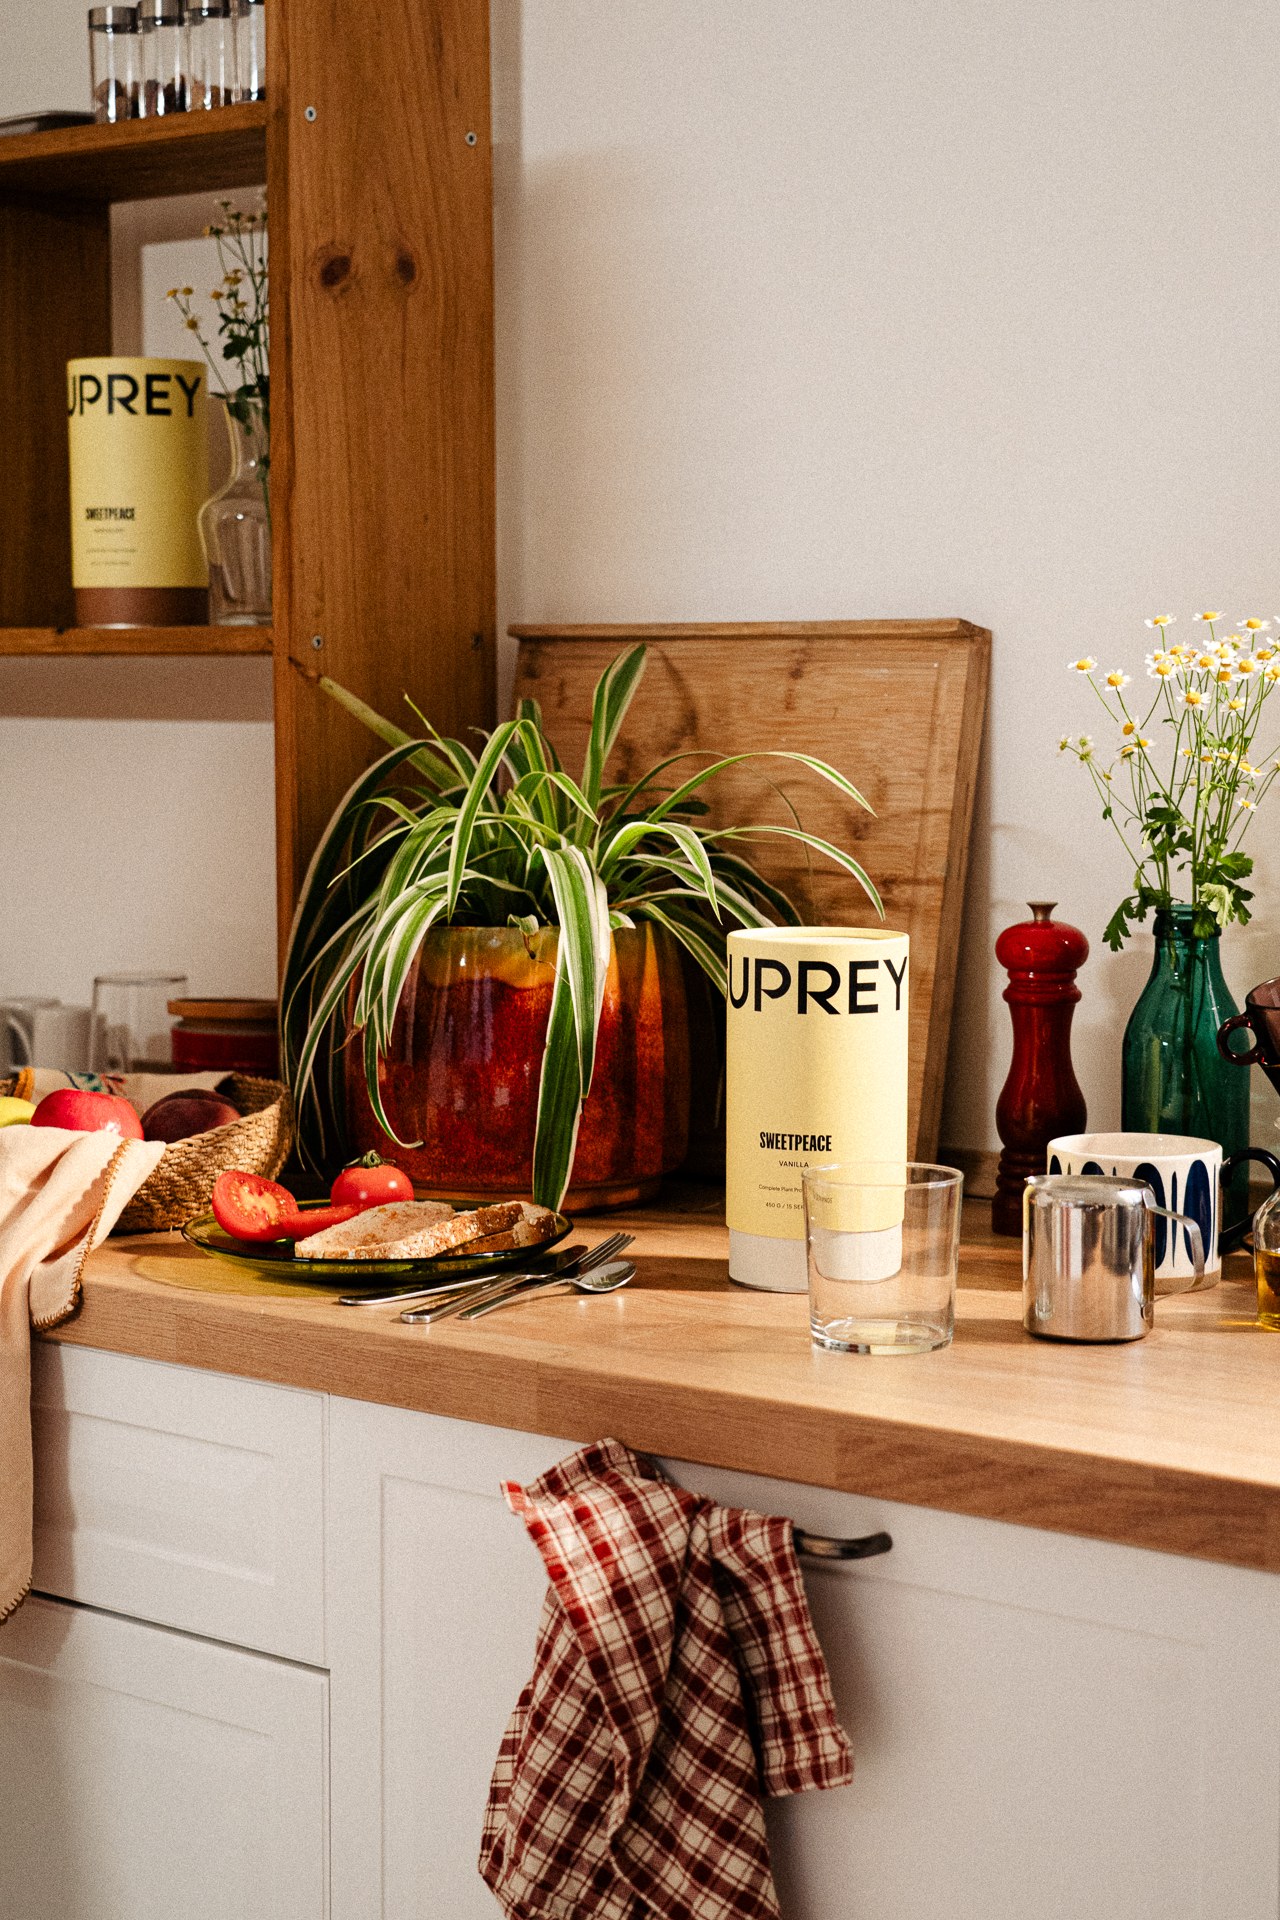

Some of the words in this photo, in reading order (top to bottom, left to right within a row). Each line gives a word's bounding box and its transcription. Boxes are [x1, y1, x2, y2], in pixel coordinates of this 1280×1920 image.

[729, 954, 908, 1015] UPREY
[759, 1131, 832, 1151] SWEETPEACE
[779, 1160, 809, 1168] VANILLA
